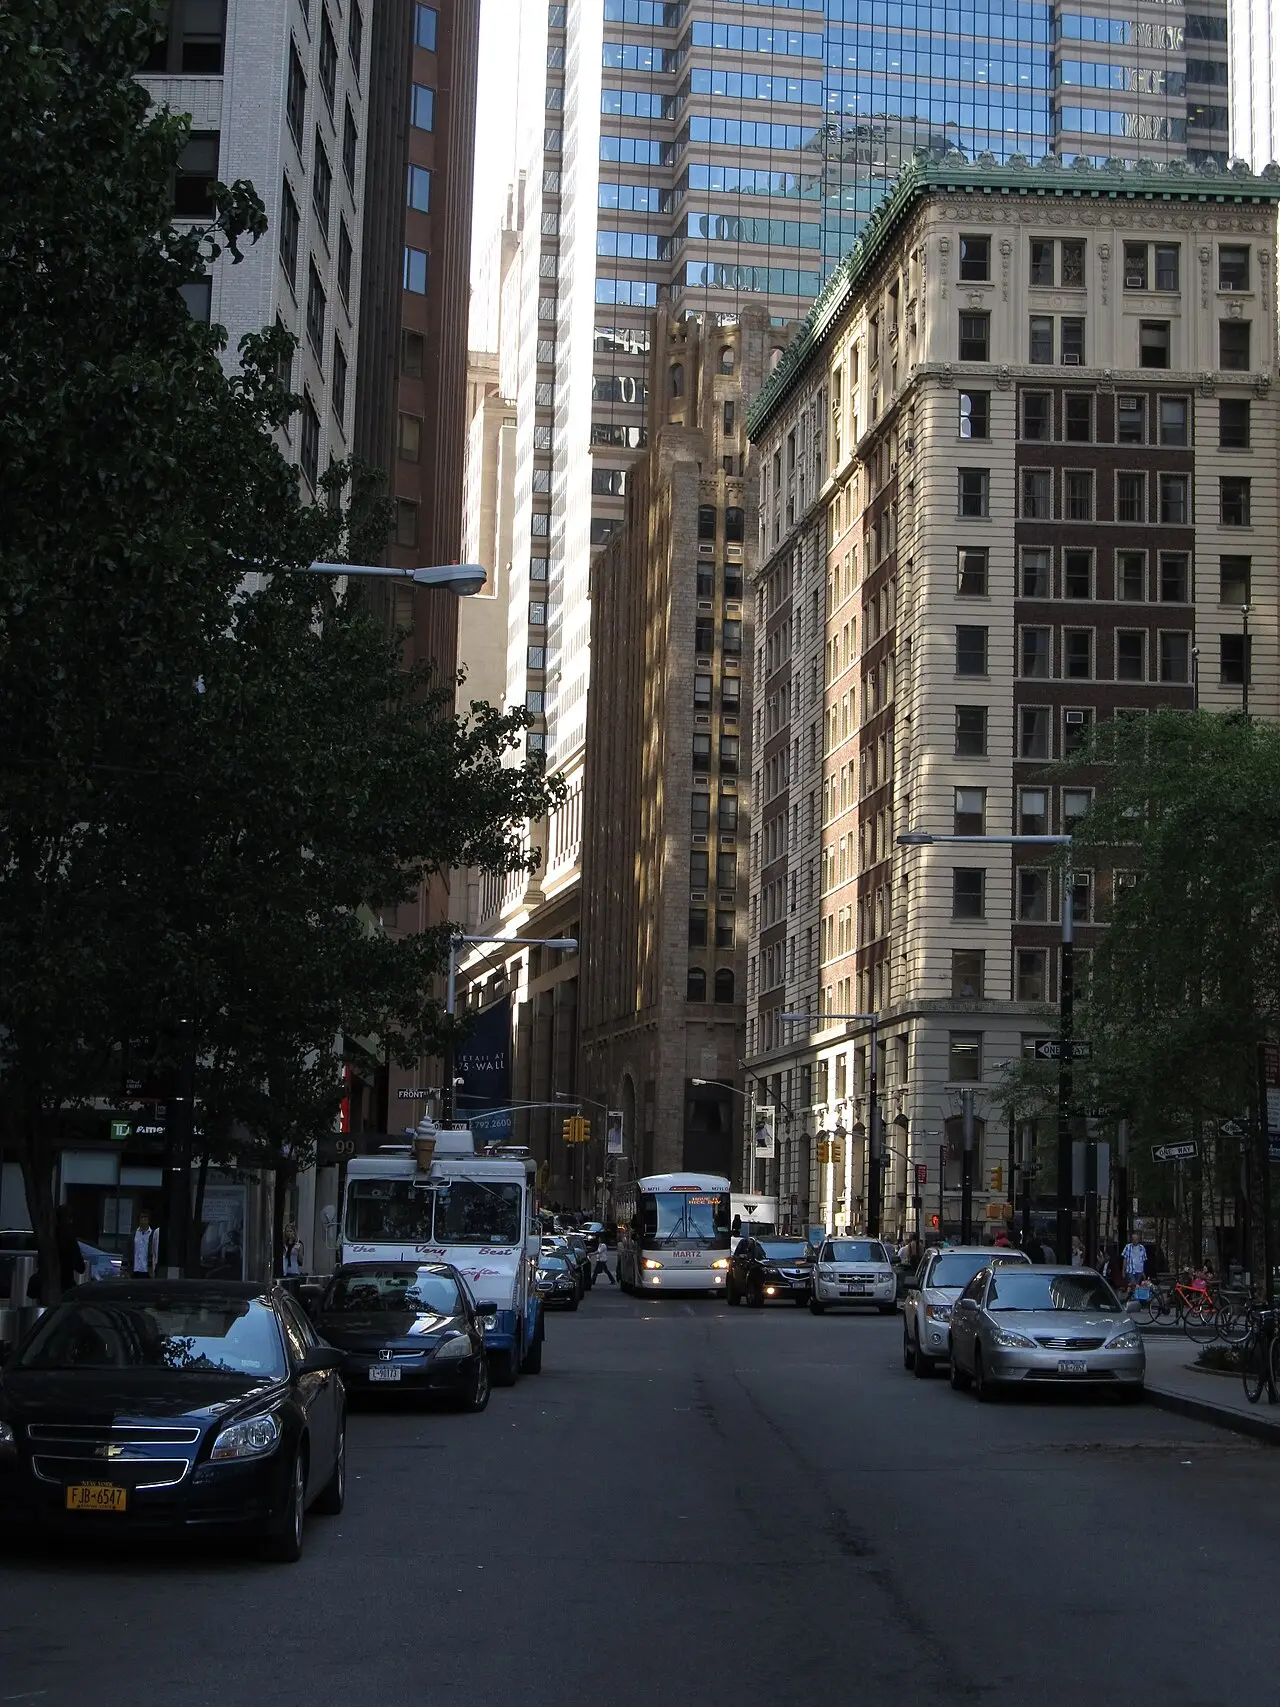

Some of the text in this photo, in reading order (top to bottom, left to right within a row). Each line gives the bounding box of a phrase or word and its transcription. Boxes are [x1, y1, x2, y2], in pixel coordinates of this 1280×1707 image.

[1044, 1045, 1061, 1054] ONE
[495, 1052, 505, 1060] AT
[475, 1060, 505, 1071] WALL
[113, 1123, 130, 1136] TD
[335, 1139, 355, 1154] 99
[1178, 1146, 1191, 1154] WAY
[415, 1246, 448, 1257] Very
